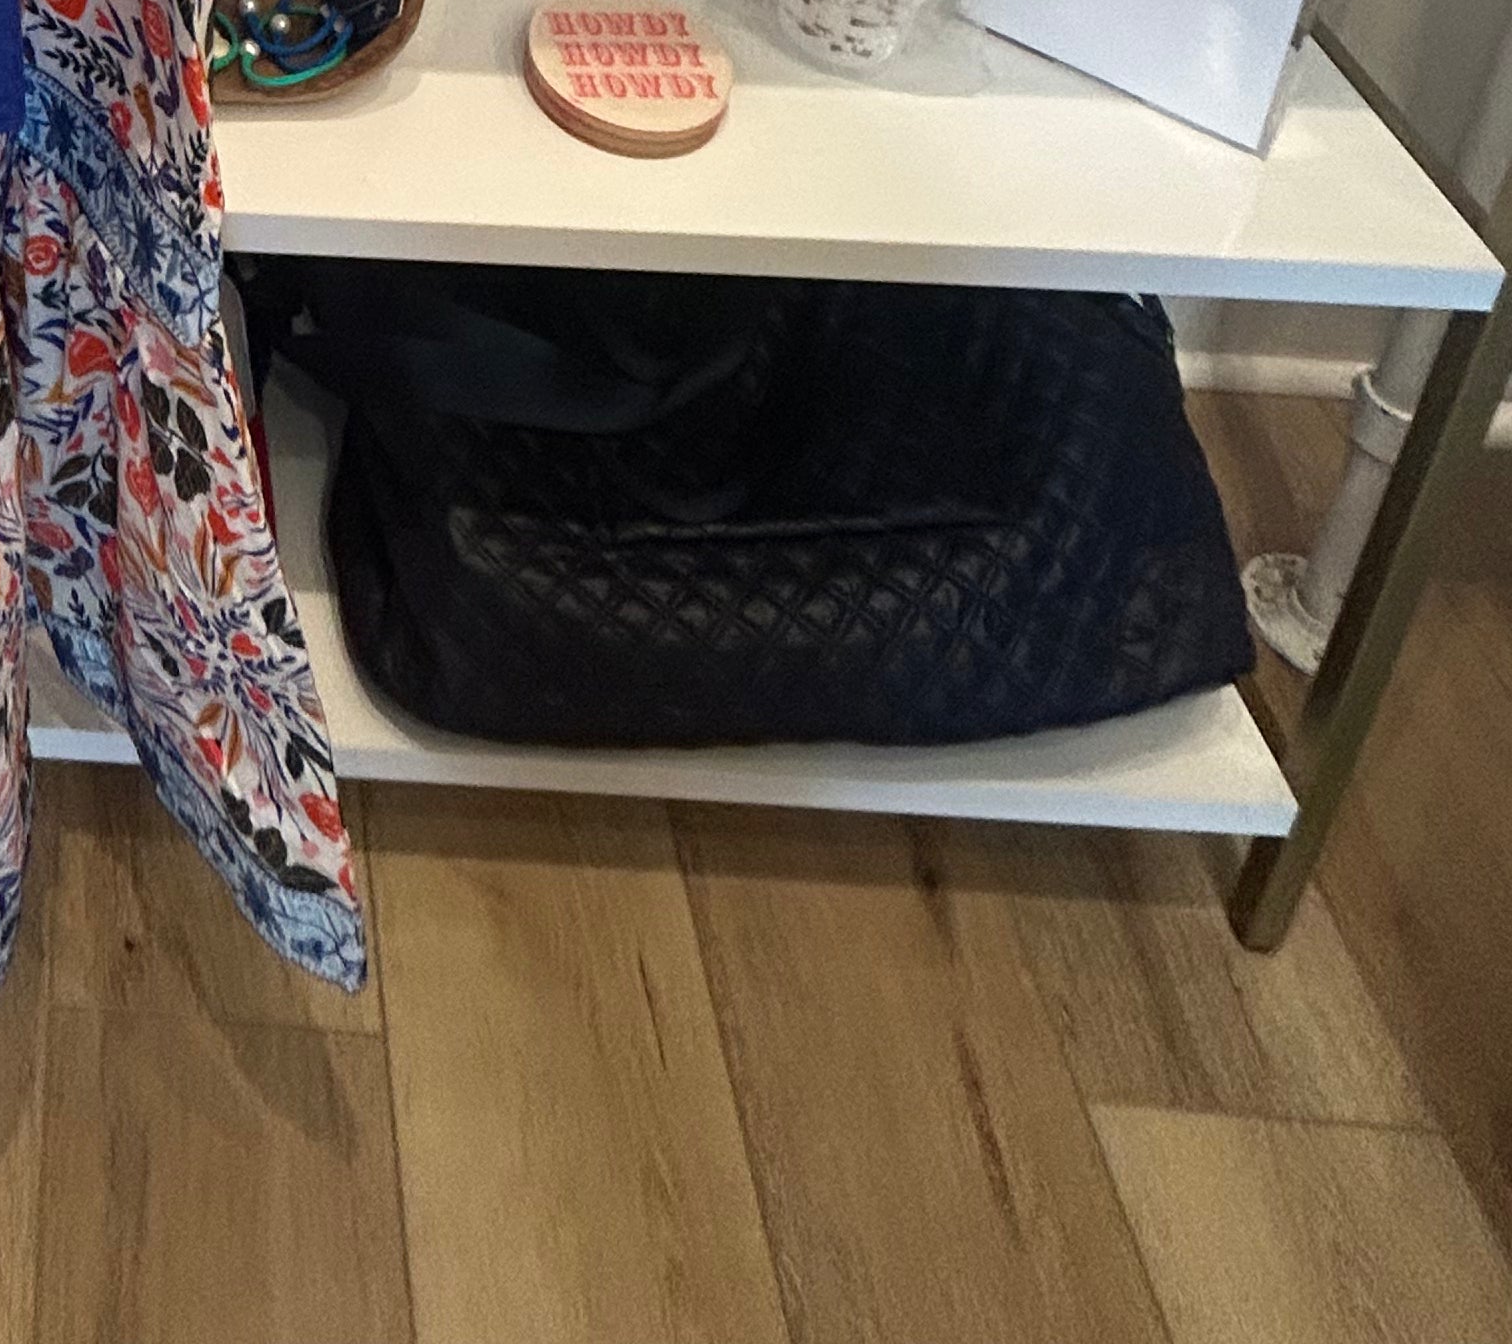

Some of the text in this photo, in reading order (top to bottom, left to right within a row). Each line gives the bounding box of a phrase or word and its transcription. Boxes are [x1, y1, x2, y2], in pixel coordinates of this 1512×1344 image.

[544, 11, 689, 37] HOWDY
[555, 41, 704, 68] HOWDY
[566, 72, 719, 100] HOWDY
